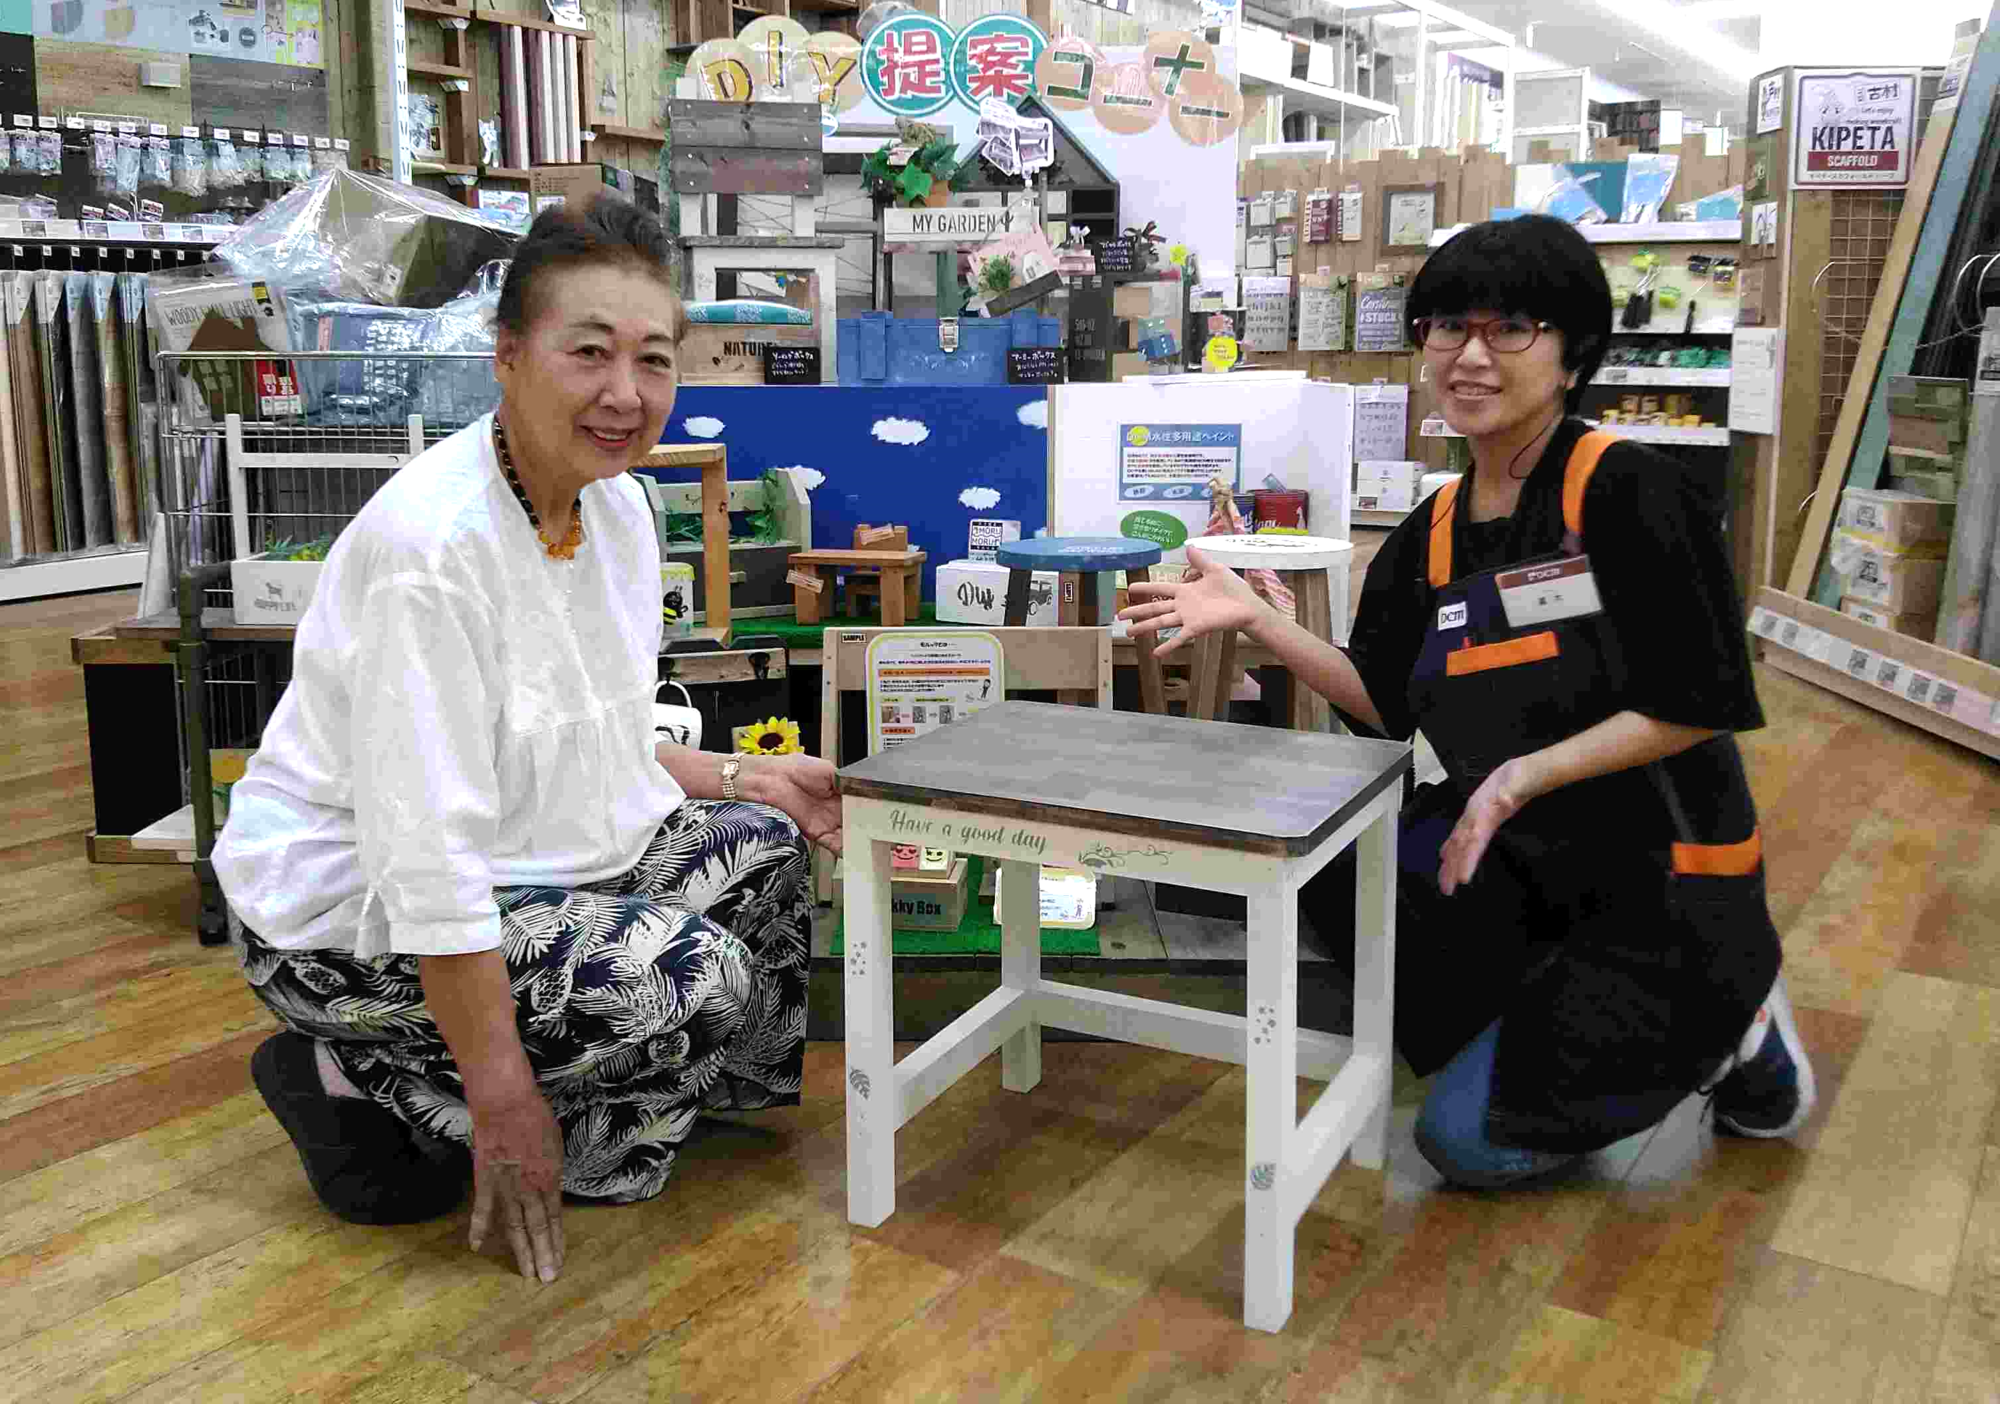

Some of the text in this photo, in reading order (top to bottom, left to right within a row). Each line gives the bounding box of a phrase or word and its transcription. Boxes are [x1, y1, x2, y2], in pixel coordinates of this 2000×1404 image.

[1811, 125, 1896, 150] KIPETA
[1827, 155, 1878, 167] SCAFFOLD
[912, 212, 997, 234] MY GARDEN
[164, 305, 200, 326] WOODY
[843, 634, 865, 642] SAMPLE
[889, 809, 1048, 855] Have a good day
[917, 900, 942, 915] Box
